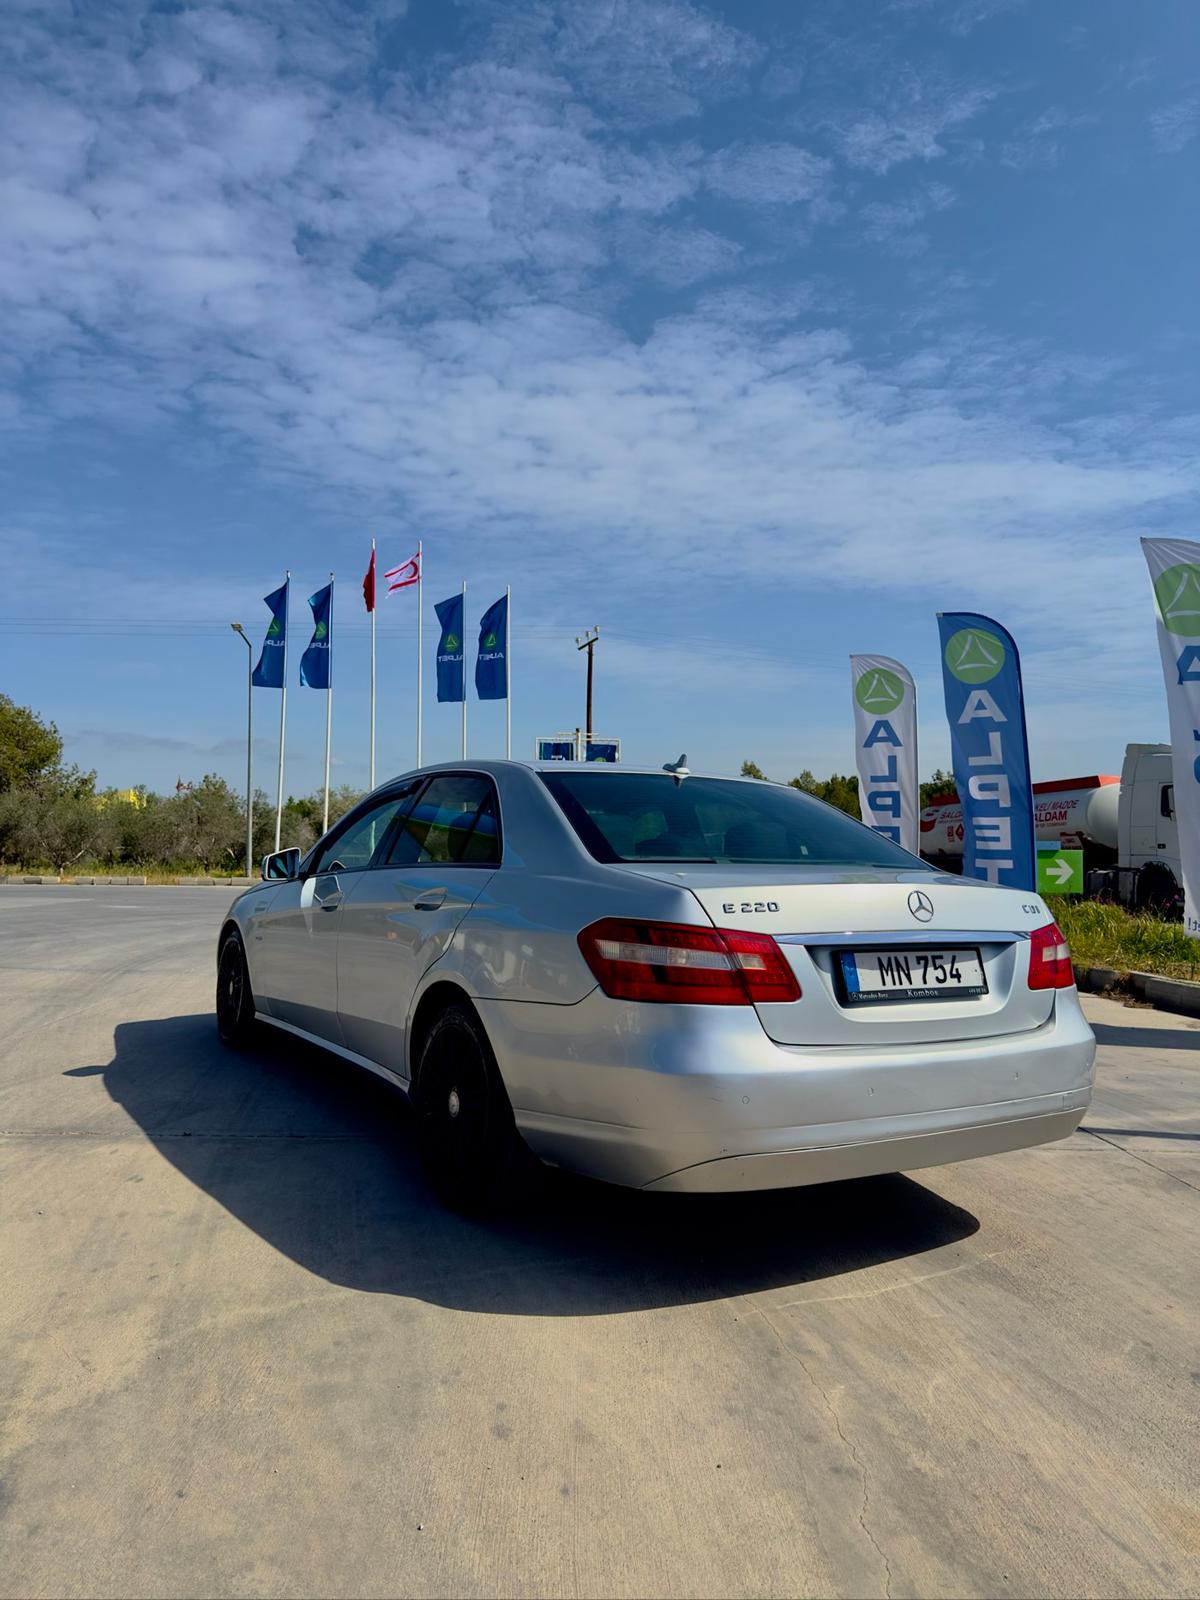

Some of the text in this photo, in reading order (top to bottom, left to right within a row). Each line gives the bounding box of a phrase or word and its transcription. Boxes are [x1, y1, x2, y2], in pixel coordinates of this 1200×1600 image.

[722, 901, 780, 914] E 220
[877, 954, 962, 987] MN 754
[907, 988, 939, 998] Kombos
